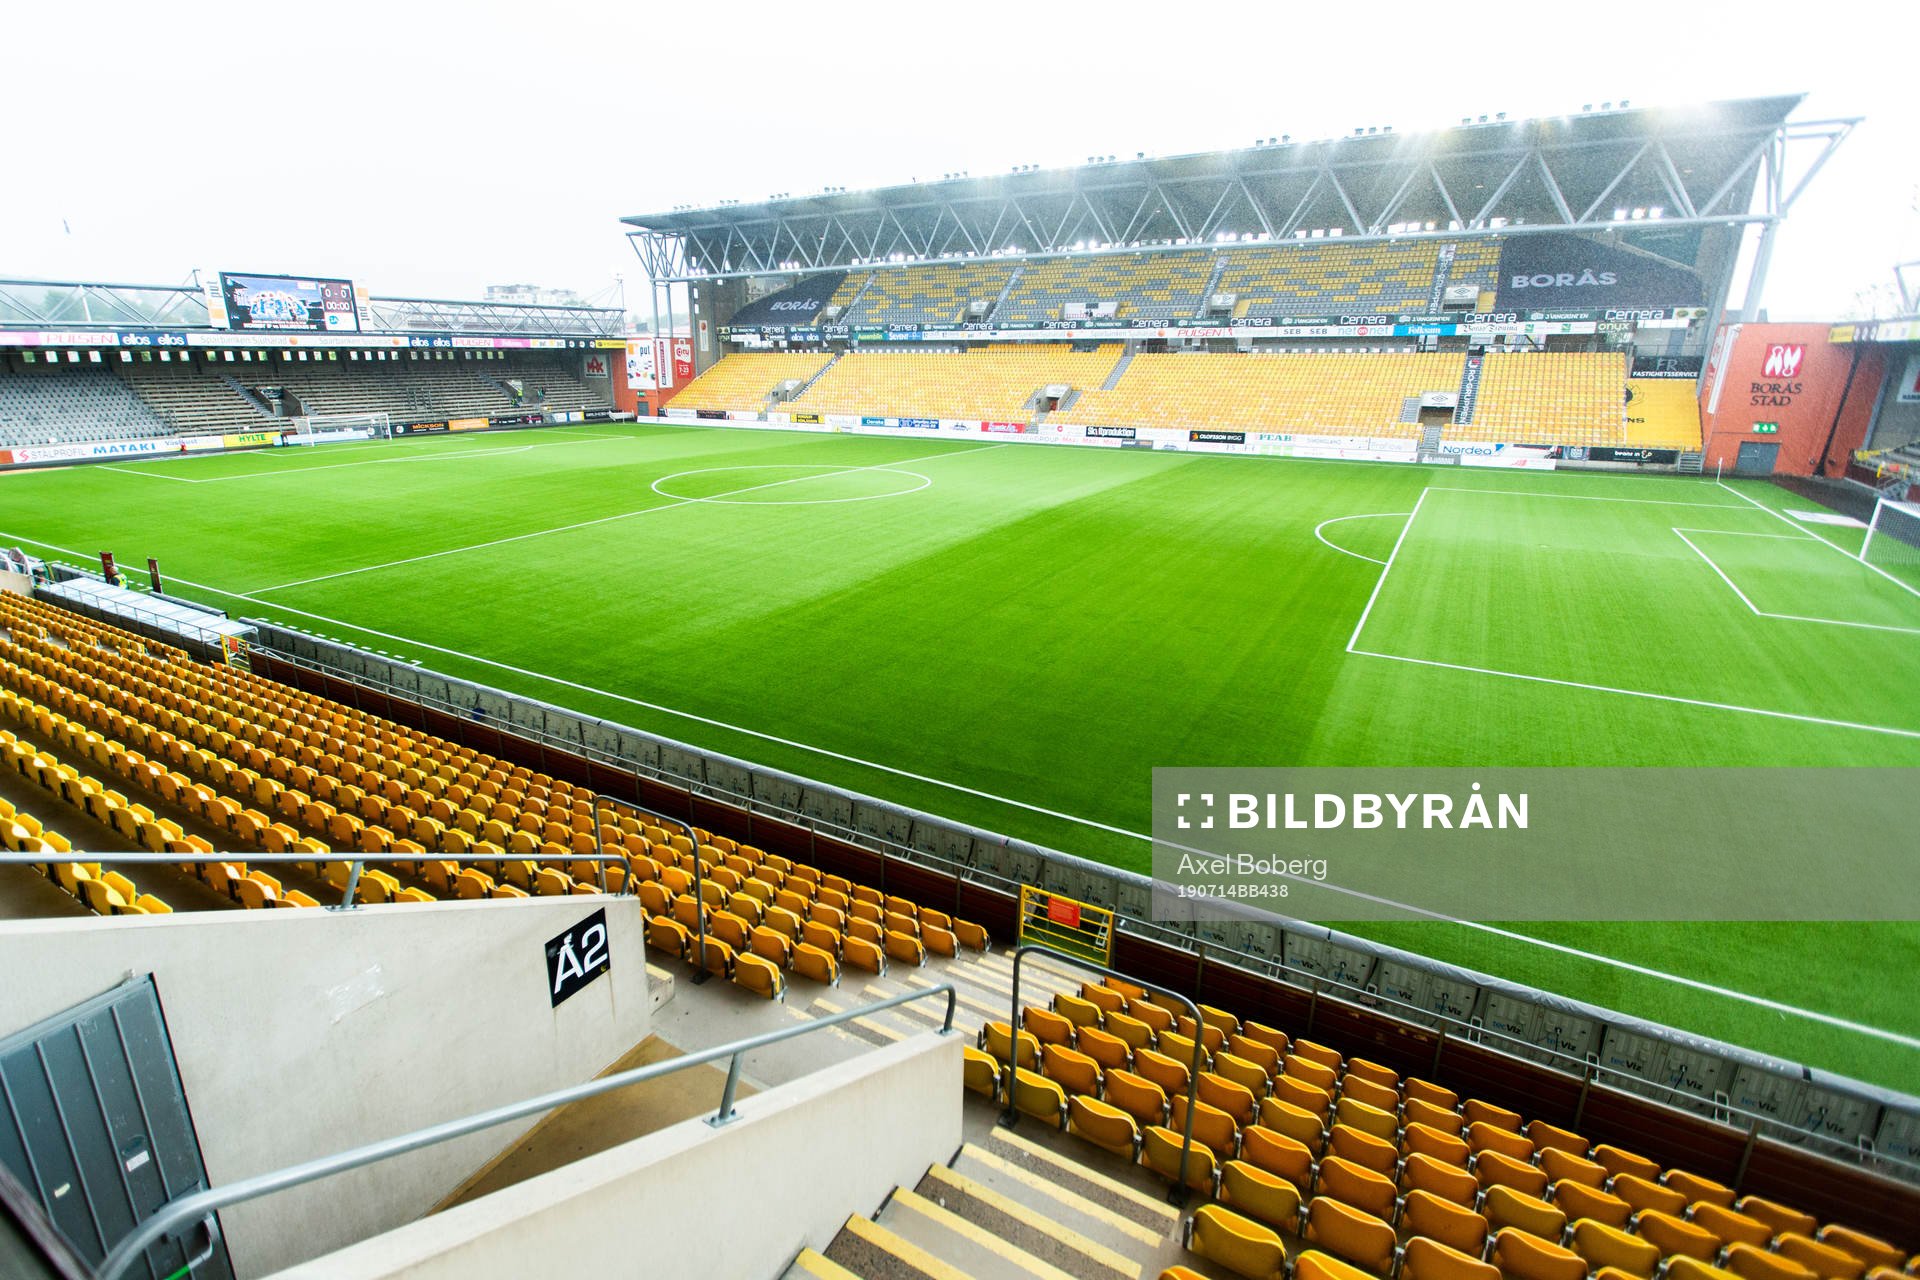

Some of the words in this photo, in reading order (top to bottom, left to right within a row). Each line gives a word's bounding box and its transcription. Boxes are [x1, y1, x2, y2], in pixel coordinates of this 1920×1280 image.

[1512, 268, 1617, 288] BORÅS
[326, 301, 350, 310] 00:00
[770, 298, 819, 310] BORÅS
[1465, 313, 1517, 323] Cernera
[1605, 310, 1664, 320] Cernera
[1043, 320, 1077, 328] Cernera
[1132, 319, 1169, 327] Cernera
[1230, 318, 1272, 326] Cernera
[1340, 316, 1387, 325] Cernera
[1599, 322, 1630, 332] onyx
[47, 334, 113, 344] PULSEN
[1750, 381, 1802, 394] BORÅS
[1750, 395, 1791, 406] STAD
[1259, 434, 1293, 442] PEAB
[94, 443, 156, 454] MATAKI
[1443, 445, 1492, 456] Nordea
[554, 923, 608, 994] Å2
[1492, 1020, 1521, 1035] tecViz
[1610, 1057, 1643, 1072] tecViz
[1741, 1096, 1777, 1113] tecViz
